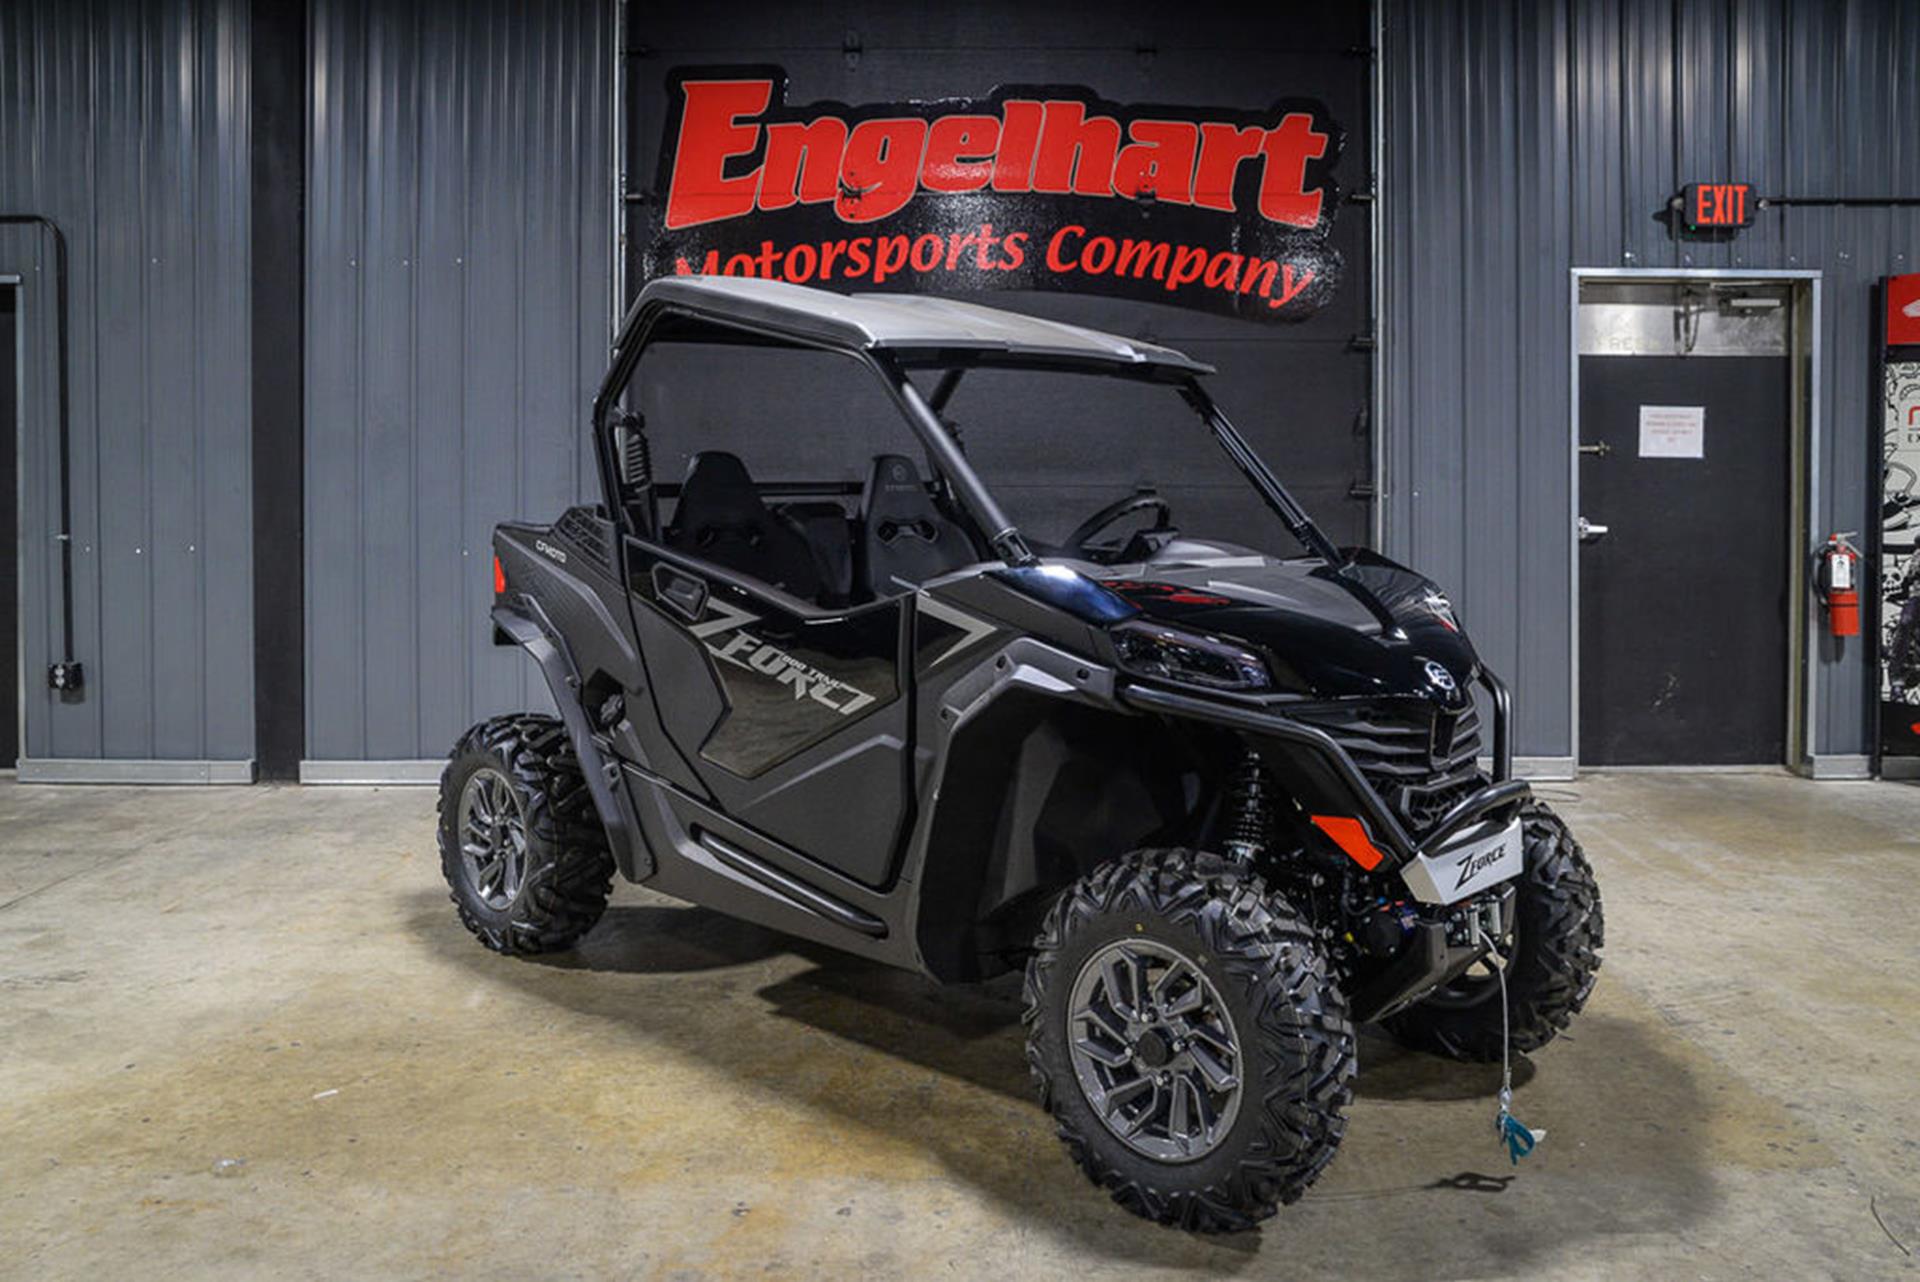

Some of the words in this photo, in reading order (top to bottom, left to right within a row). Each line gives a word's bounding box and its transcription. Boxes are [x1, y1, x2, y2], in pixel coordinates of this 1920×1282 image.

[666, 79, 1328, 230] Engelhart
[1696, 184, 1748, 224] EXIT
[1045, 224, 1315, 309] Company
[1455, 843, 1506, 890] ZFORCE
